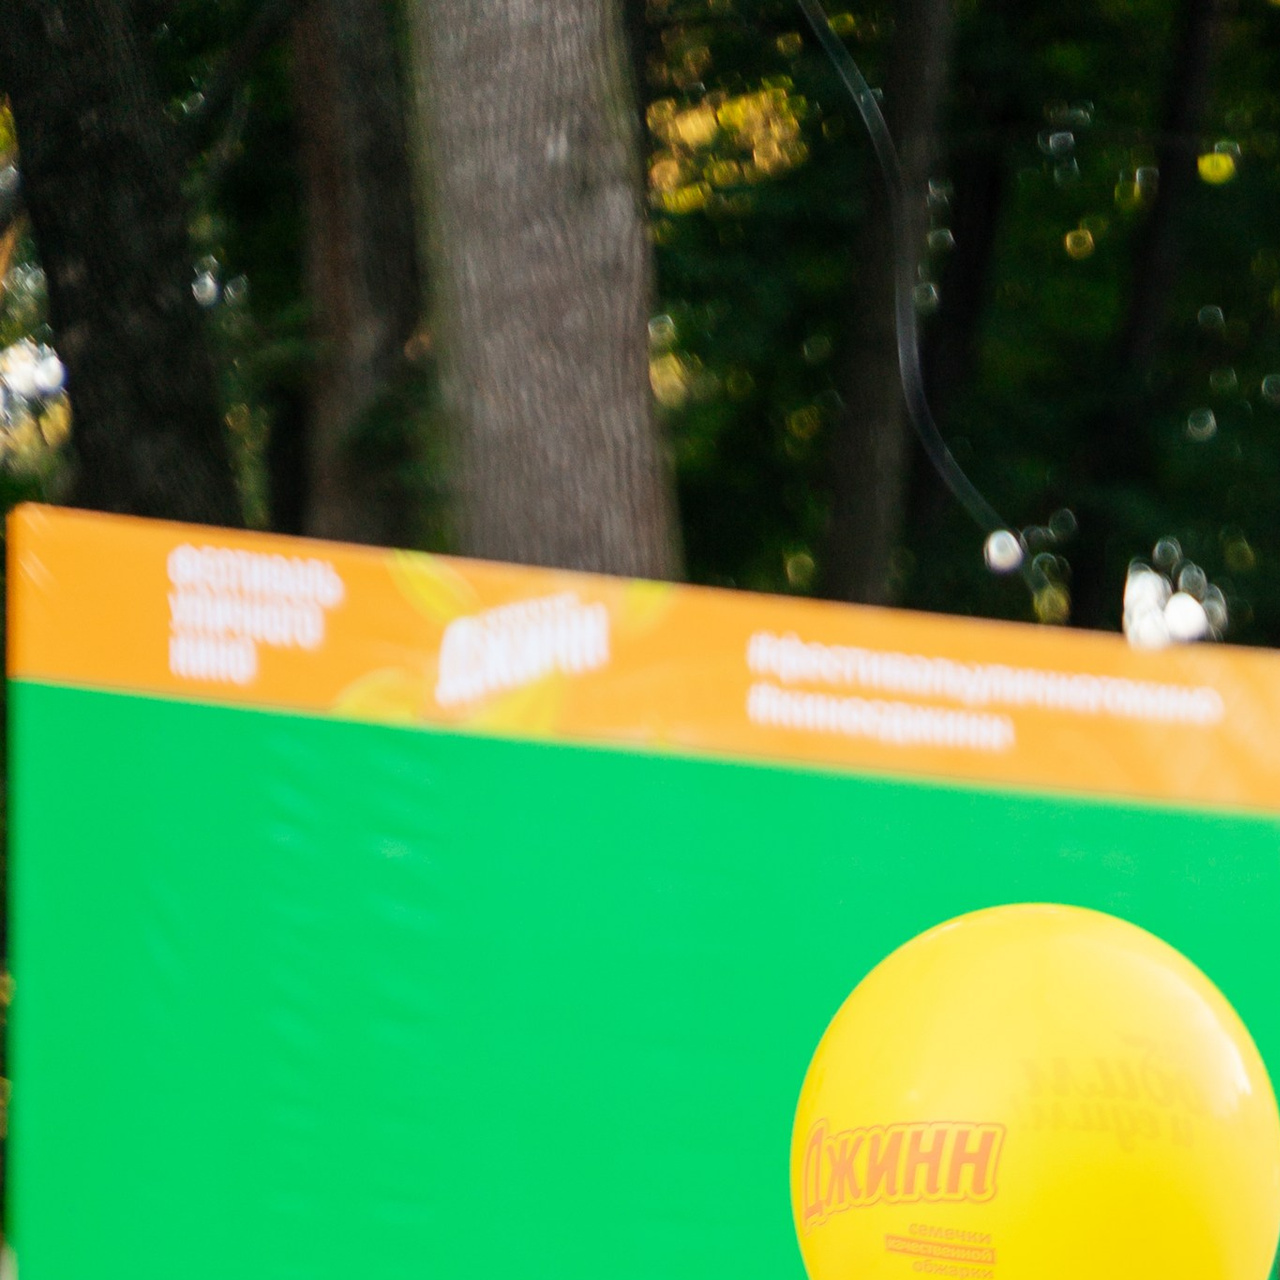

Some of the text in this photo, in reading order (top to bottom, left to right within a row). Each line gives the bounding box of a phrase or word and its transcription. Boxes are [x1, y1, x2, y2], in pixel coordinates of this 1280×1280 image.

[803, 1124, 999, 1224] ДЖИНН
[908, 1222, 991, 1244] семечки
[911, 1258, 994, 1280] обжарки
